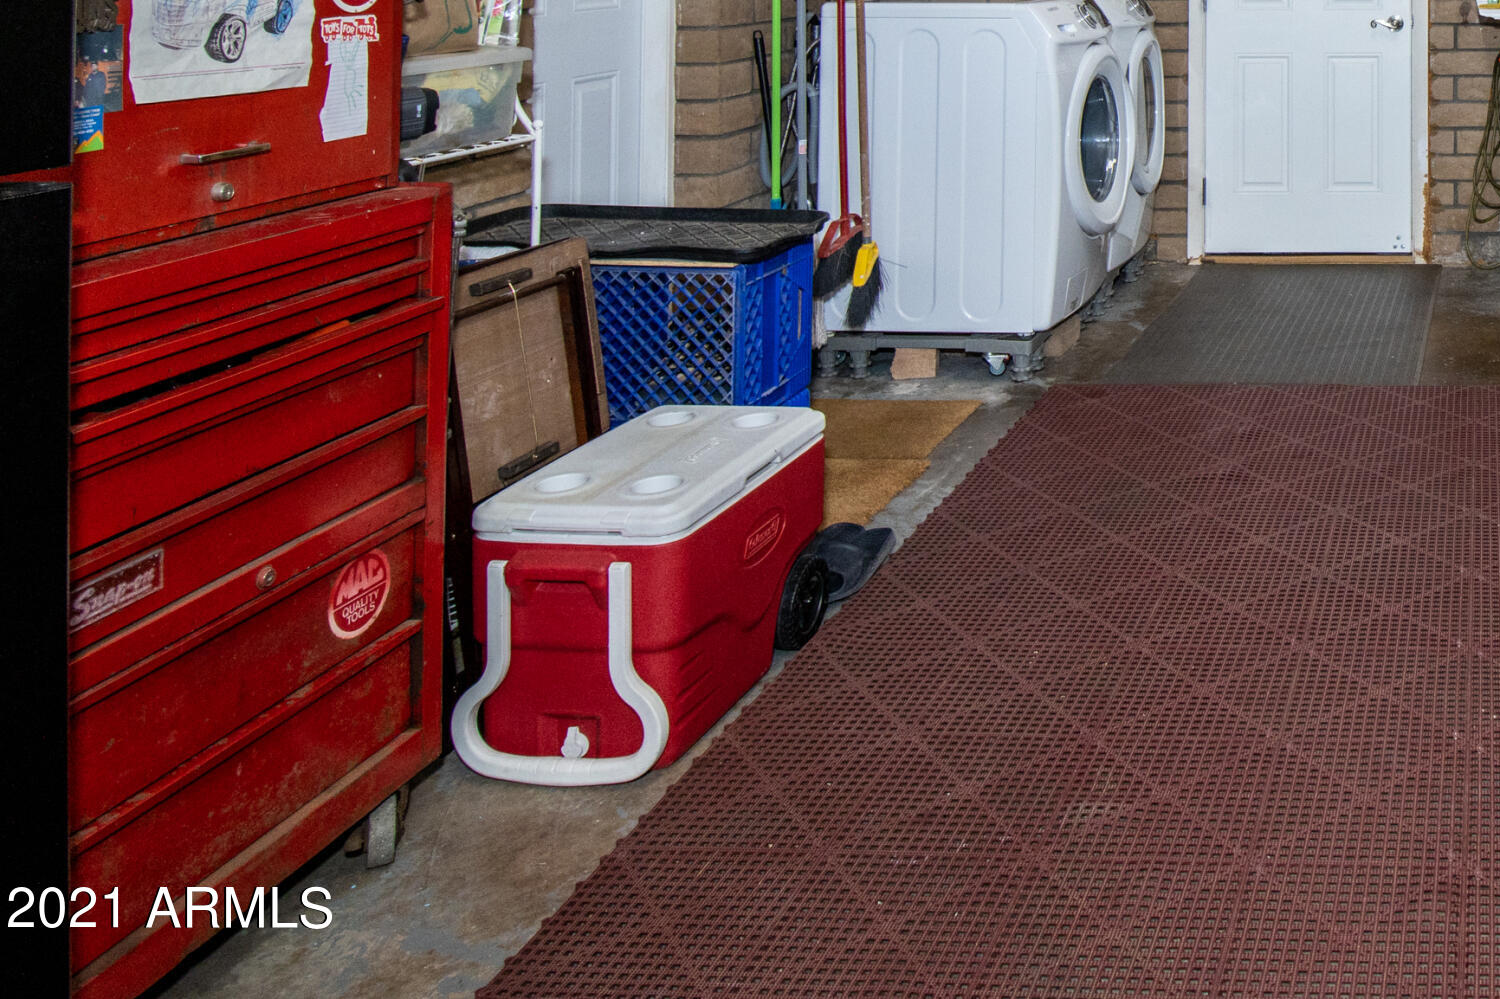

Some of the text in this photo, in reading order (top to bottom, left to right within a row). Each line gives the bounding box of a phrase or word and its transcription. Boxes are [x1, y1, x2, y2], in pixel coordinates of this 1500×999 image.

[335, 558, 384, 607] MAC
[342, 588, 380, 619] QUALITY
[346, 601, 375, 625] TOOLS
